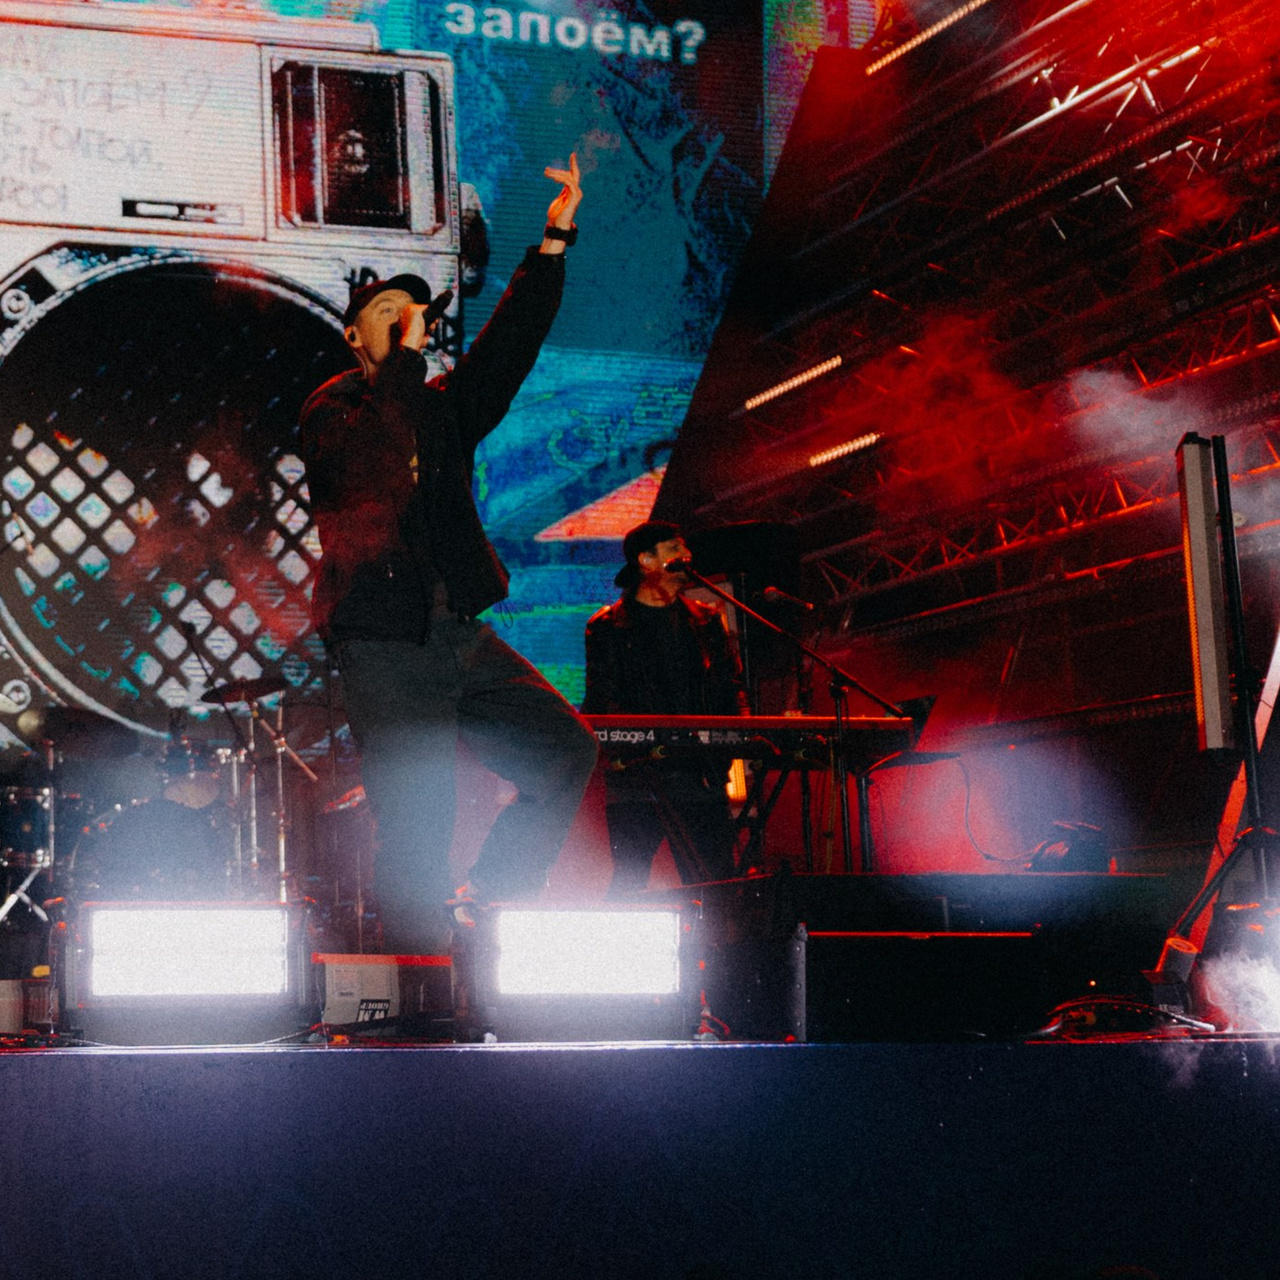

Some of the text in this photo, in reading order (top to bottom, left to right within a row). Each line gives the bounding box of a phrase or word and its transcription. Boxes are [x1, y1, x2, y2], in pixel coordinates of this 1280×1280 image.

[444, 2, 706, 62] запоём?
[610, 730, 646, 744] stage
[646, 730, 655, 742] 4
